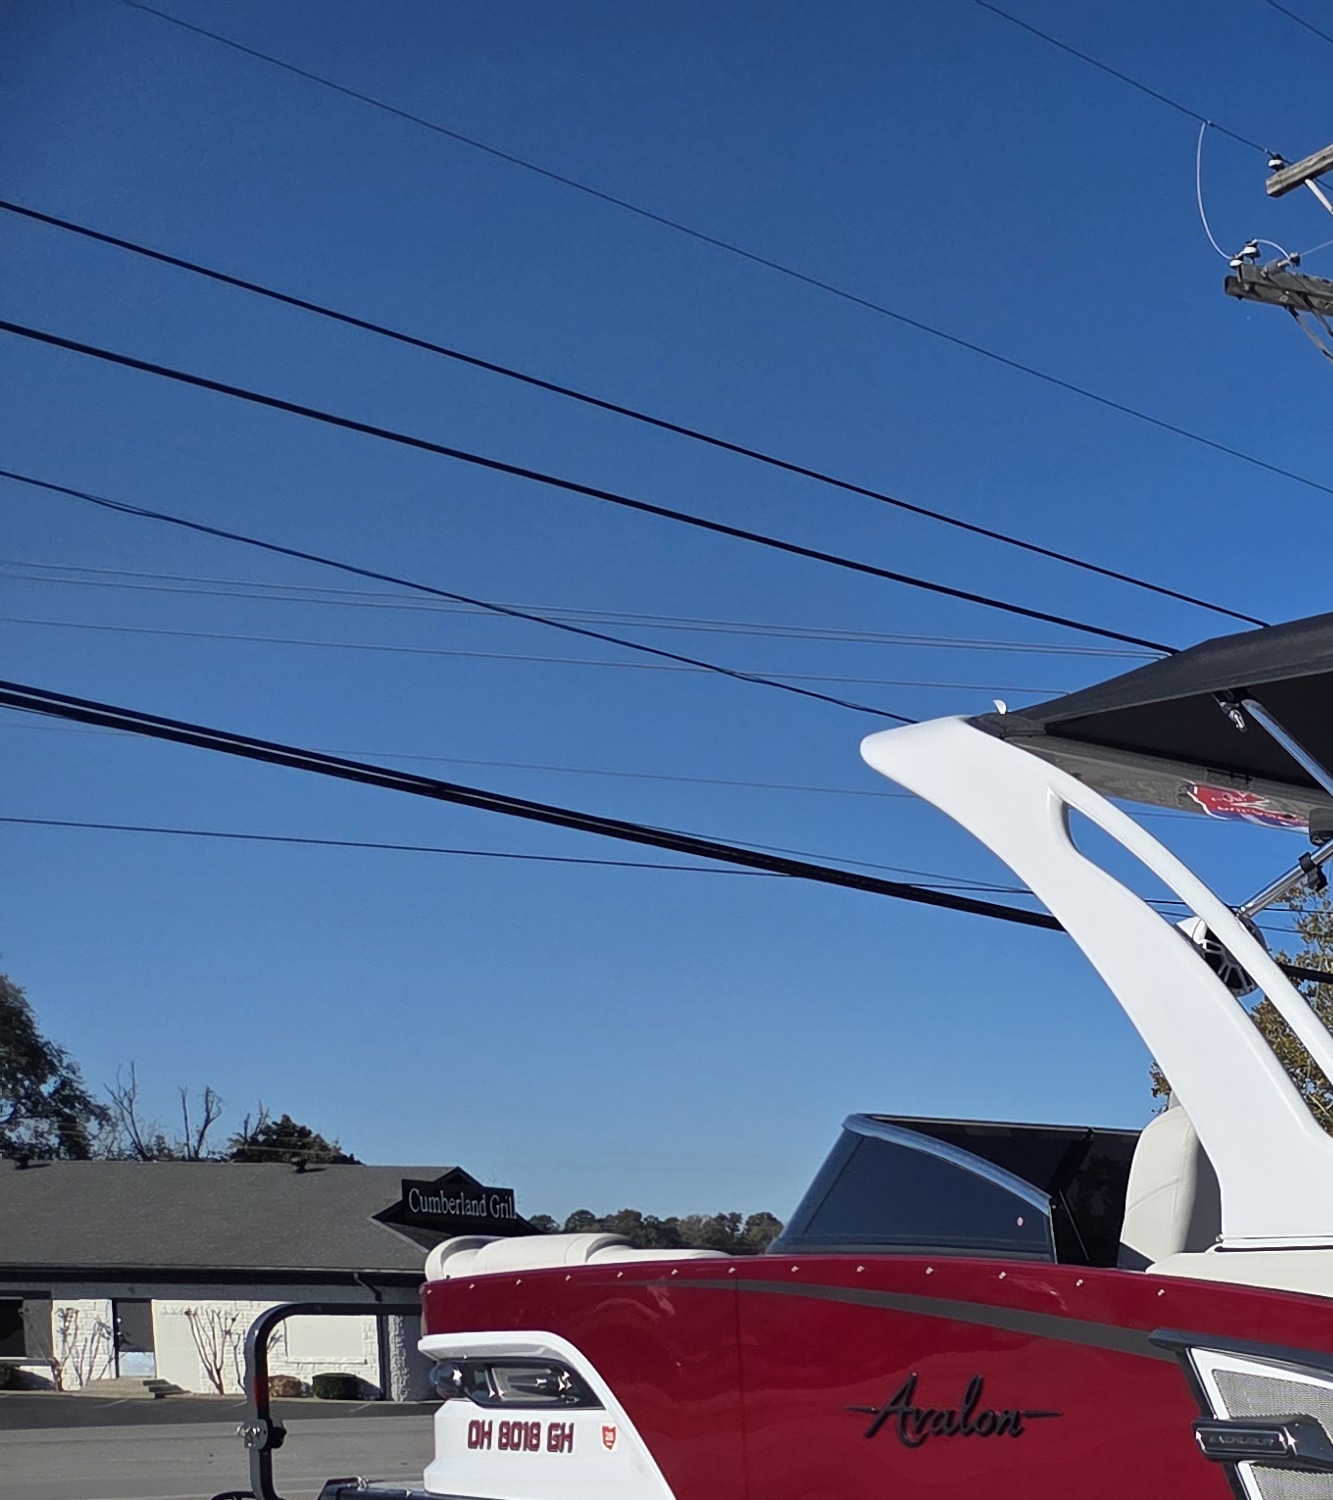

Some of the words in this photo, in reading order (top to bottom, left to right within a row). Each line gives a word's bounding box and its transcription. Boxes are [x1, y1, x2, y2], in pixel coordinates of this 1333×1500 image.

[408, 1187, 487, 1217] Cumberland
[490, 1194, 517, 1219] Grill
[843, 1372, 1063, 1448] Avalon
[468, 1419, 493, 1450] OH
[498, 1421, 541, 1452] 8018
[547, 1422, 574, 1453] GH
